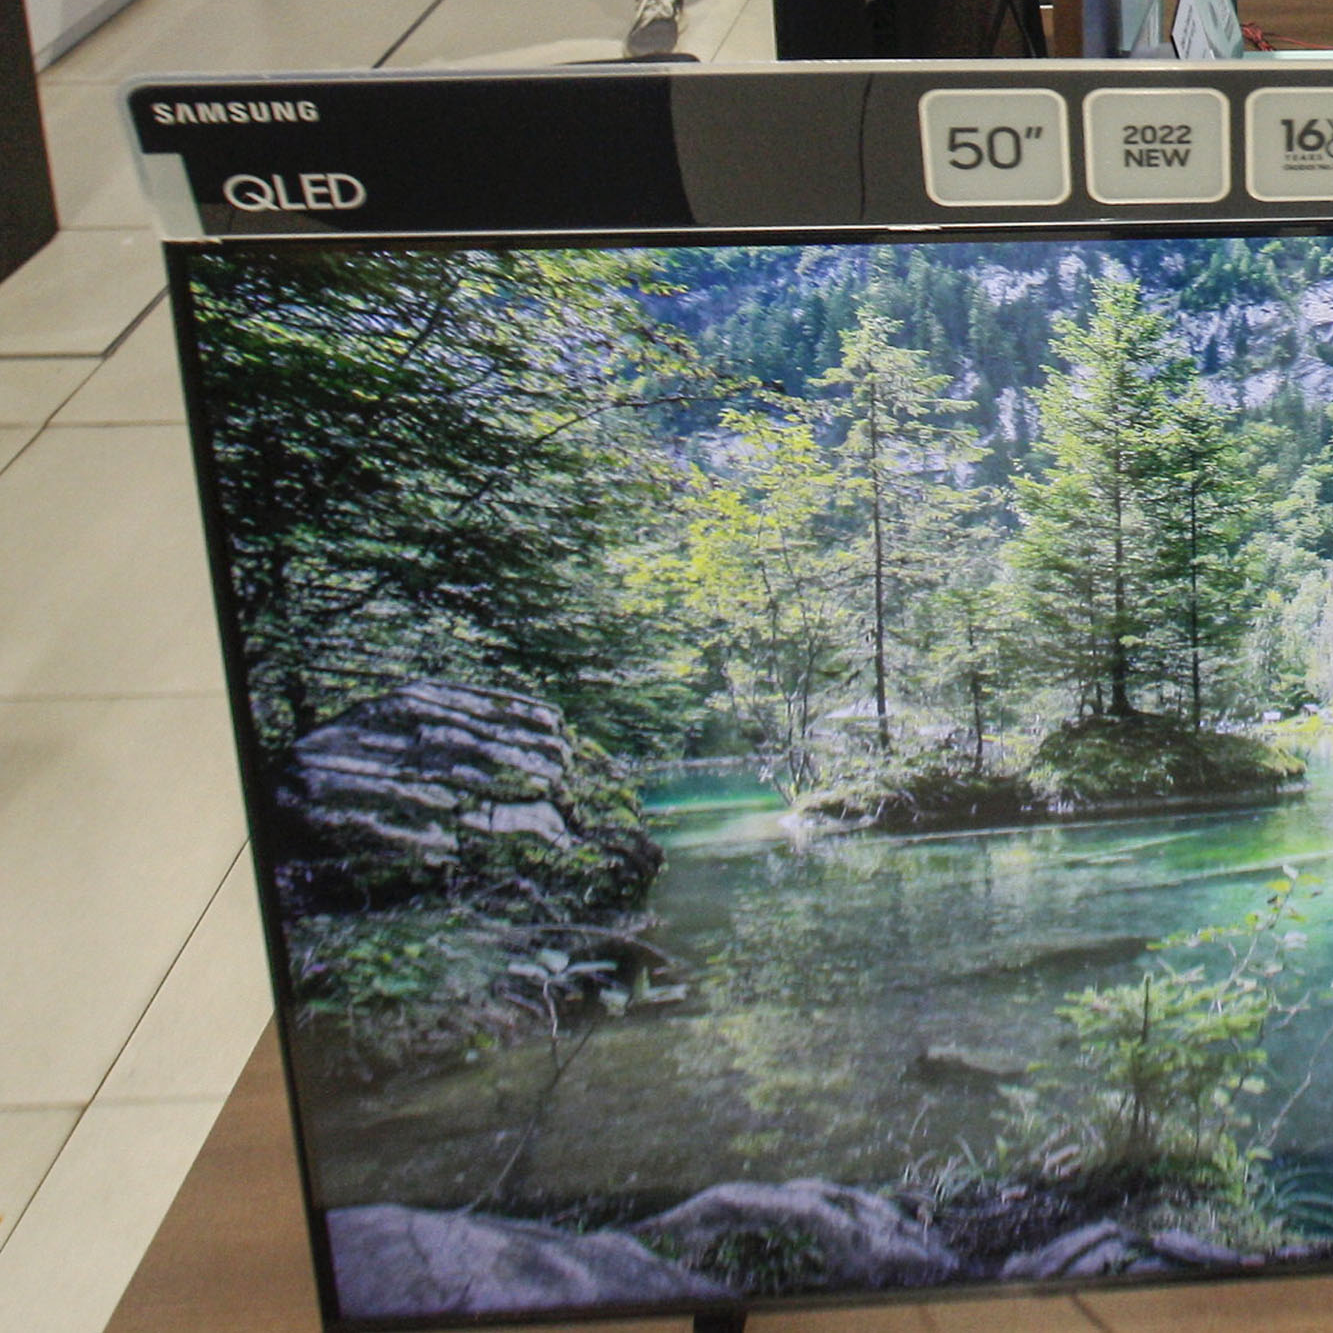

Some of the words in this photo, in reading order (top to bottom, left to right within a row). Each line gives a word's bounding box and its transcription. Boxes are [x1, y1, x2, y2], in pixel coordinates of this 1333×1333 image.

[153, 100, 320, 125] SAMSUNG
[947, 125, 1044, 170] 50"
[1122, 124, 1193, 146] 2022
[1281, 118, 1325, 152] 16
[1124, 147, 1192, 169] NEW
[1284, 153, 1323, 161] YEARS
[223, 172, 368, 214] QLED
